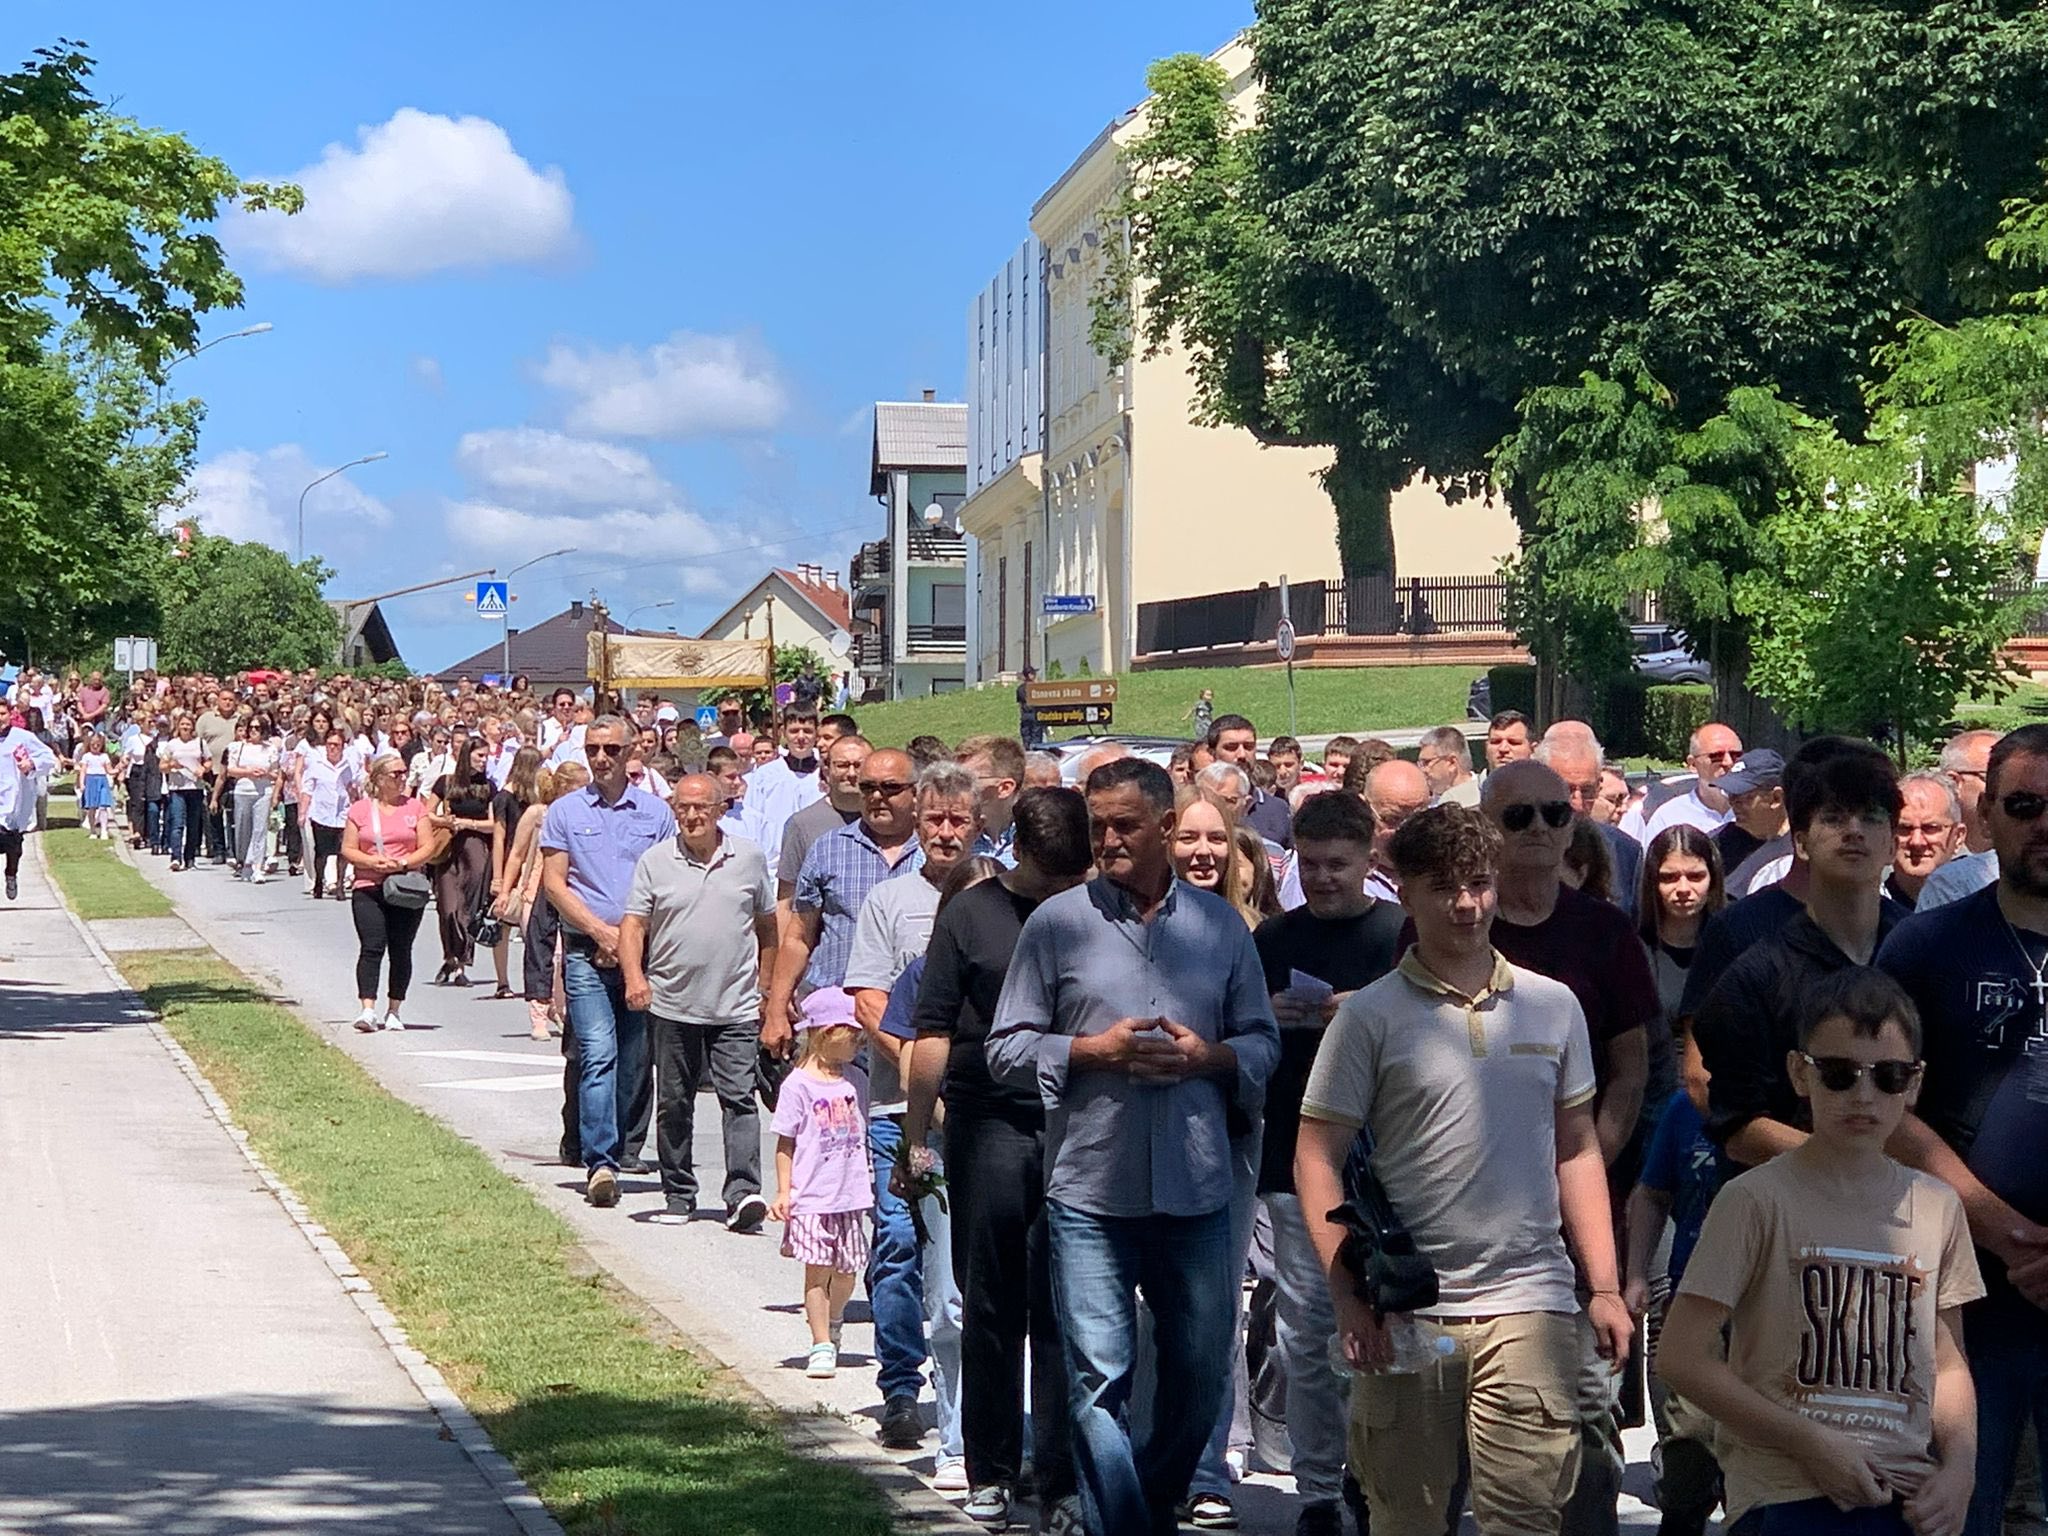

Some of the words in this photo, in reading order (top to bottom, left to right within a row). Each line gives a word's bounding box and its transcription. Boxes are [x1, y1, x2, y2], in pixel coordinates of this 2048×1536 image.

[1280, 630, 1290, 651] 30
[1031, 689, 1060, 699] Osnovna
[1036, 711, 1062, 721] Gradsko
[1796, 1264, 1922, 1397] SKATE
